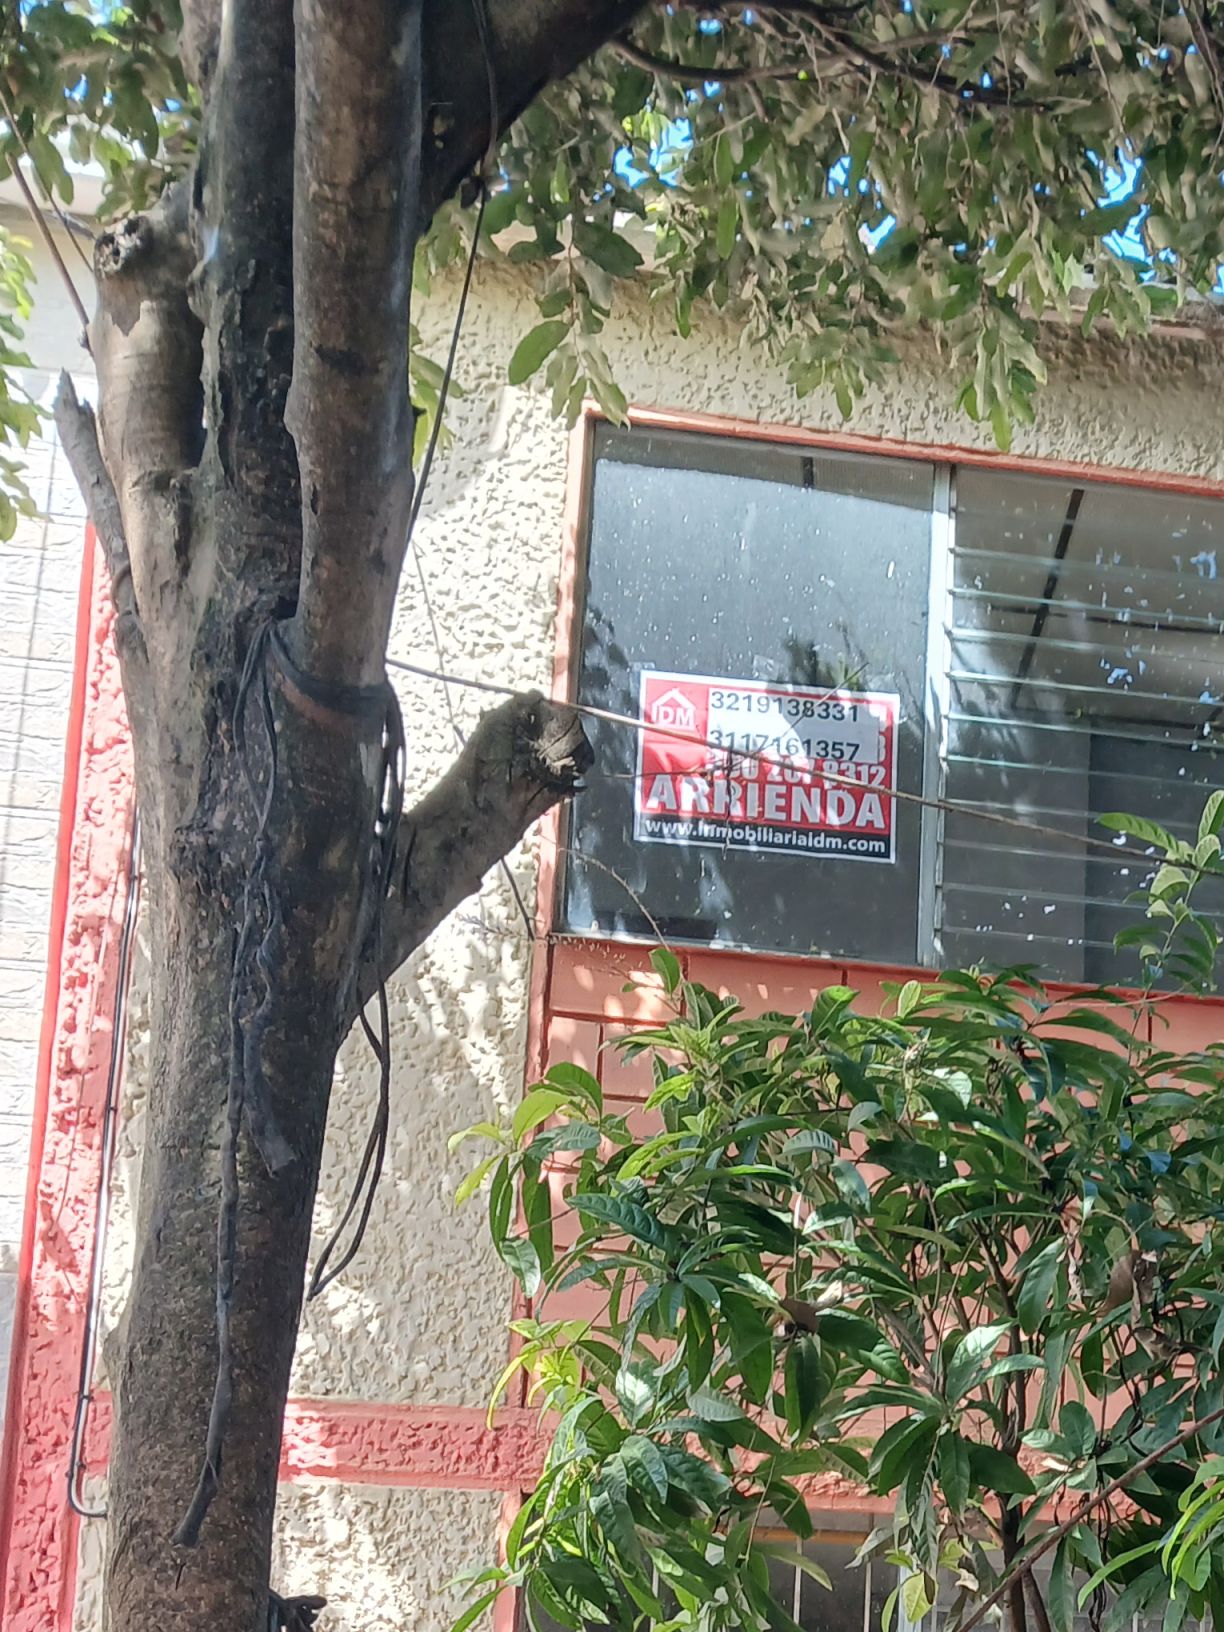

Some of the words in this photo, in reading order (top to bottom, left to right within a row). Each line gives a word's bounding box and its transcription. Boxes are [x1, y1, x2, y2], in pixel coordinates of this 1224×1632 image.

[651, 703, 696, 730] IDM
[710, 691, 859, 723] 3219138331
[709, 729, 860, 761] 3117161357
[822, 760, 887, 790] 8312
[646, 774, 887, 829] ARRIENDA
